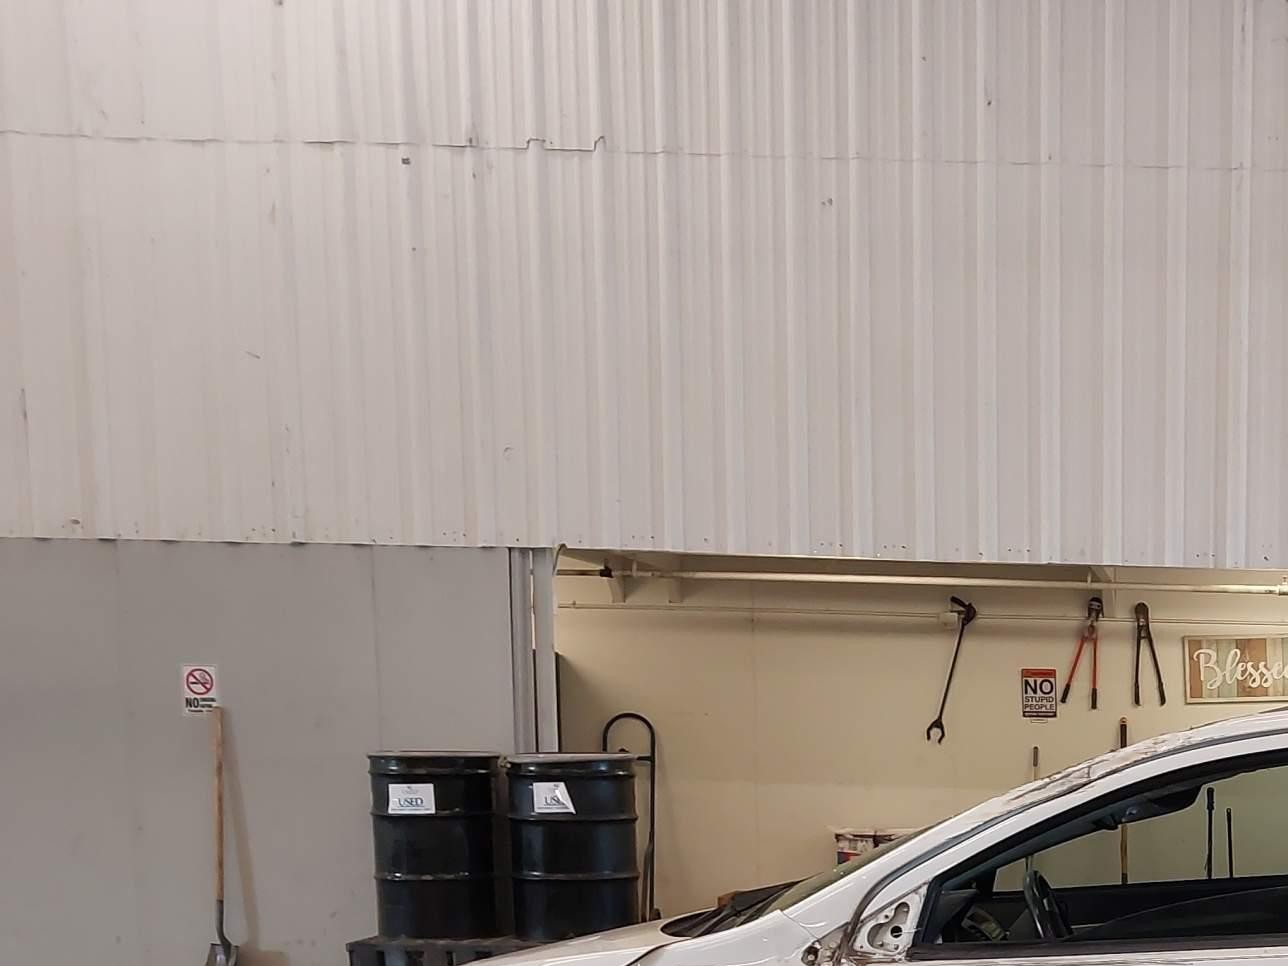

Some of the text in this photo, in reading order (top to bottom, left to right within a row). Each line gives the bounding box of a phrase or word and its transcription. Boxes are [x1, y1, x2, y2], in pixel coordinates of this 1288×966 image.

[1024, 679, 1054, 695] NO
[185, 697, 200, 708] NO
[1024, 695, 1055, 703] STUPID
[1024, 703, 1055, 711] PEOPLE
[398, 796, 424, 807] USED
